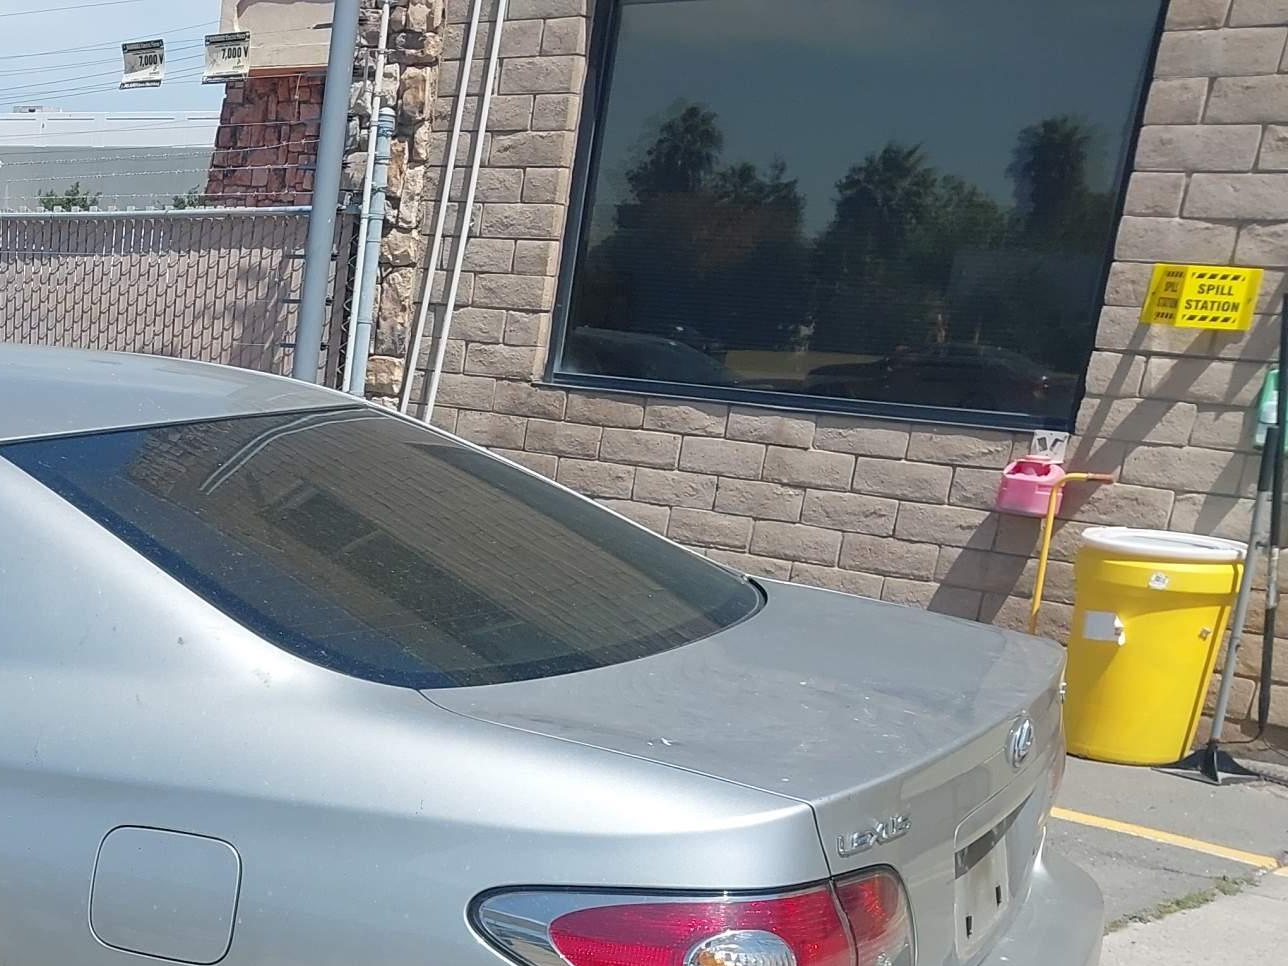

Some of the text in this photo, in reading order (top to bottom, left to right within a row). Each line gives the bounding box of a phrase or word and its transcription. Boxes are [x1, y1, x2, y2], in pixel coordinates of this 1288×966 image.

[221, 47, 242, 60] 7,000
[138, 54, 158, 67] 7,000
[1197, 283, 1234, 296] SPILL
[1184, 299, 1240, 312] STATION
[836, 815, 912, 858] LEXUS
